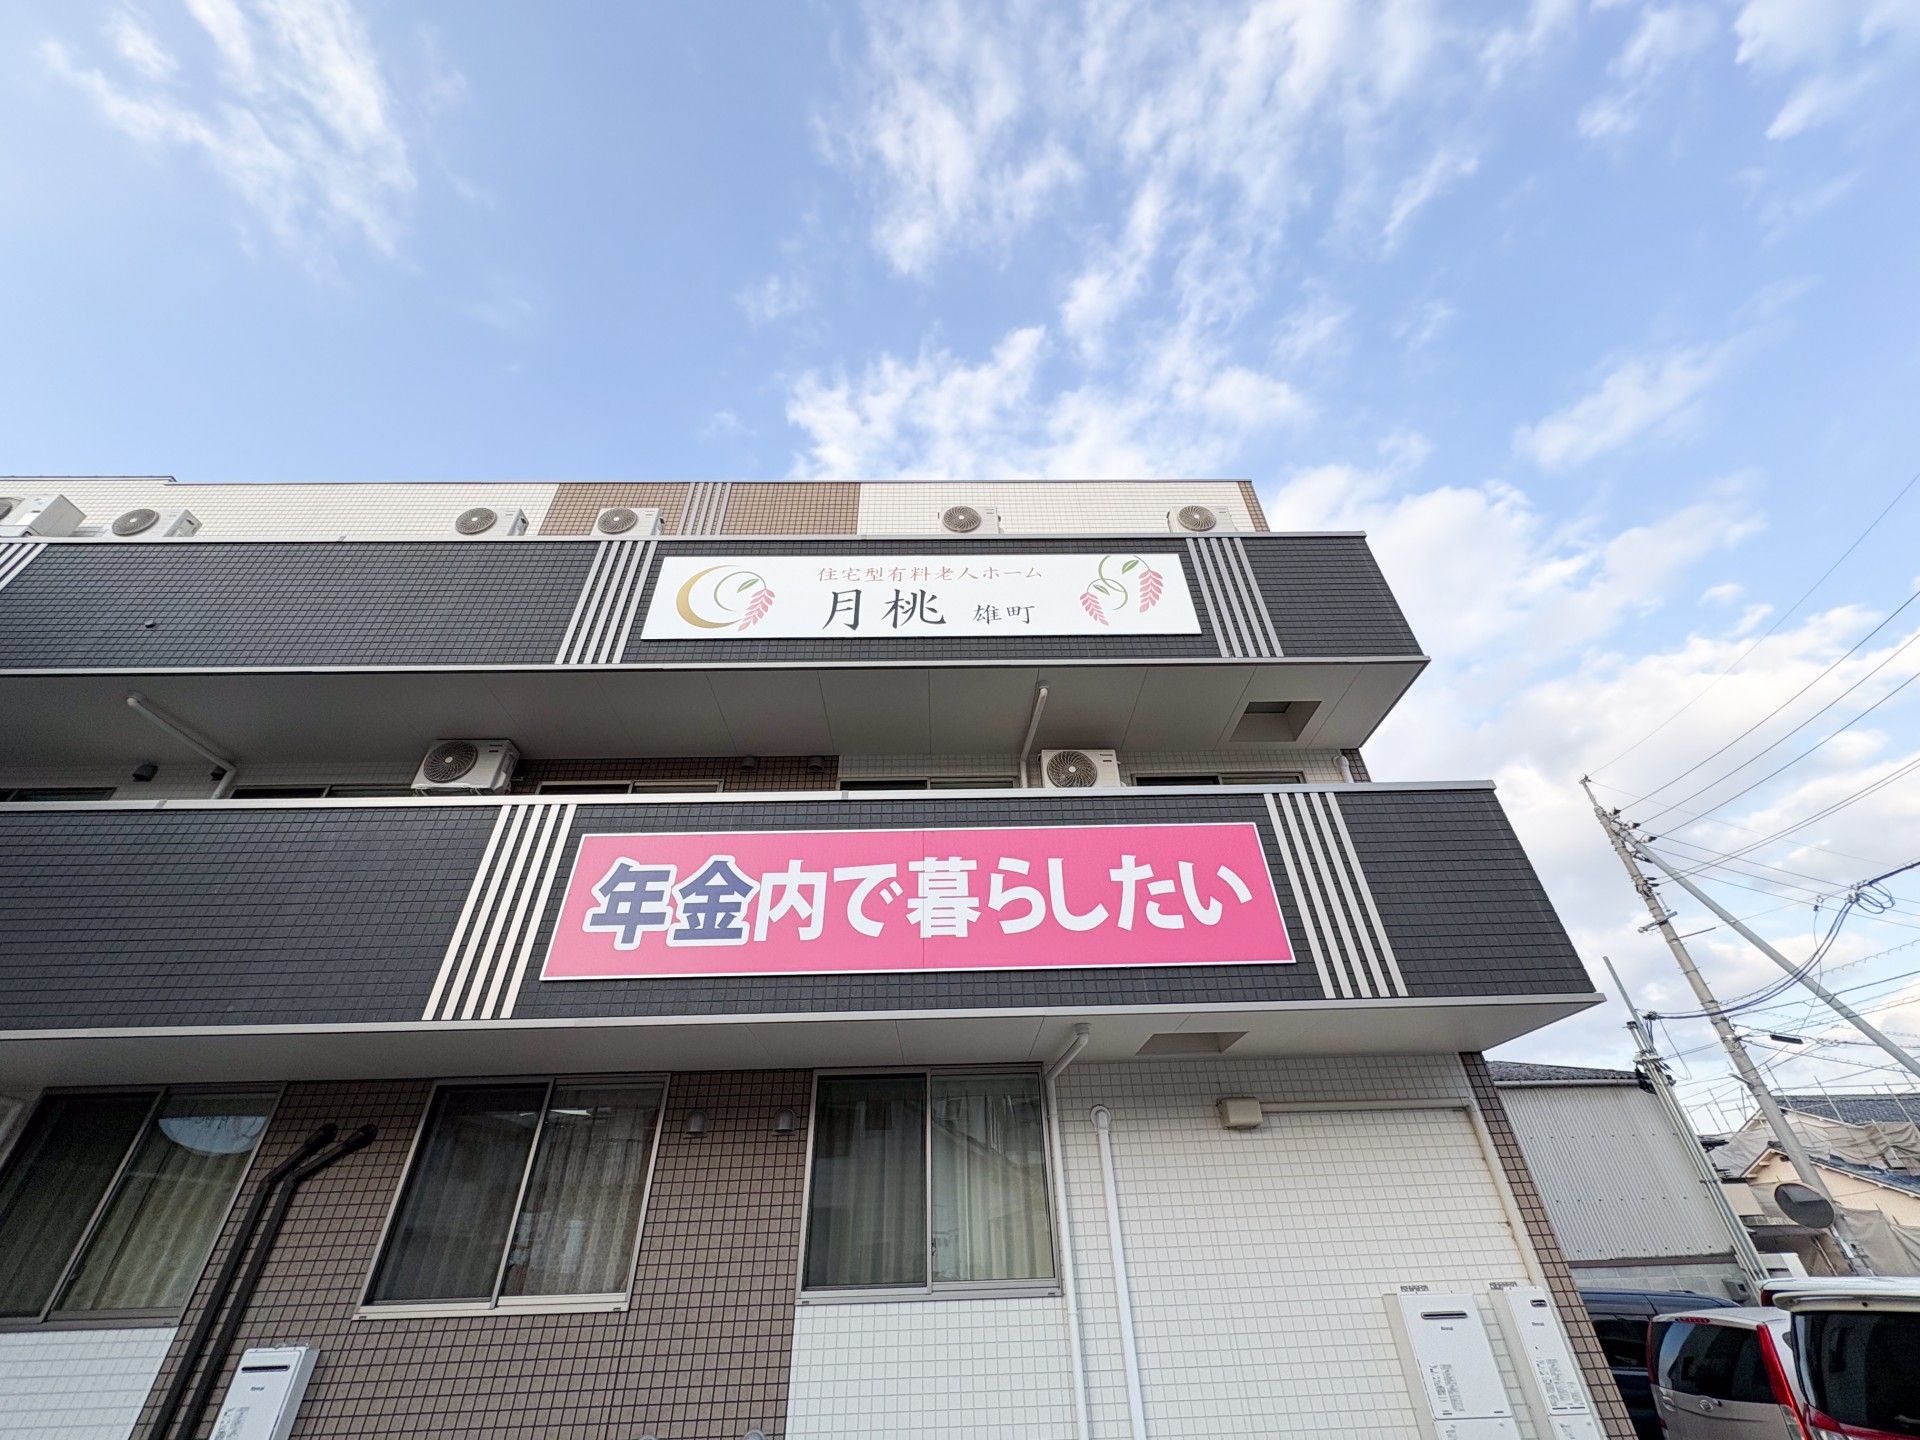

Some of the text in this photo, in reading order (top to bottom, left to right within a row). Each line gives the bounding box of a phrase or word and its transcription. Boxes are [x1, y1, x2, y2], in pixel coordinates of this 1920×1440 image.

[817, 565, 1043, 582] 住宅型有料老人ホーム
[822, 588, 1036, 631] 月桃 雄町
[582, 854, 1253, 950] 年金内で暮らしたい
